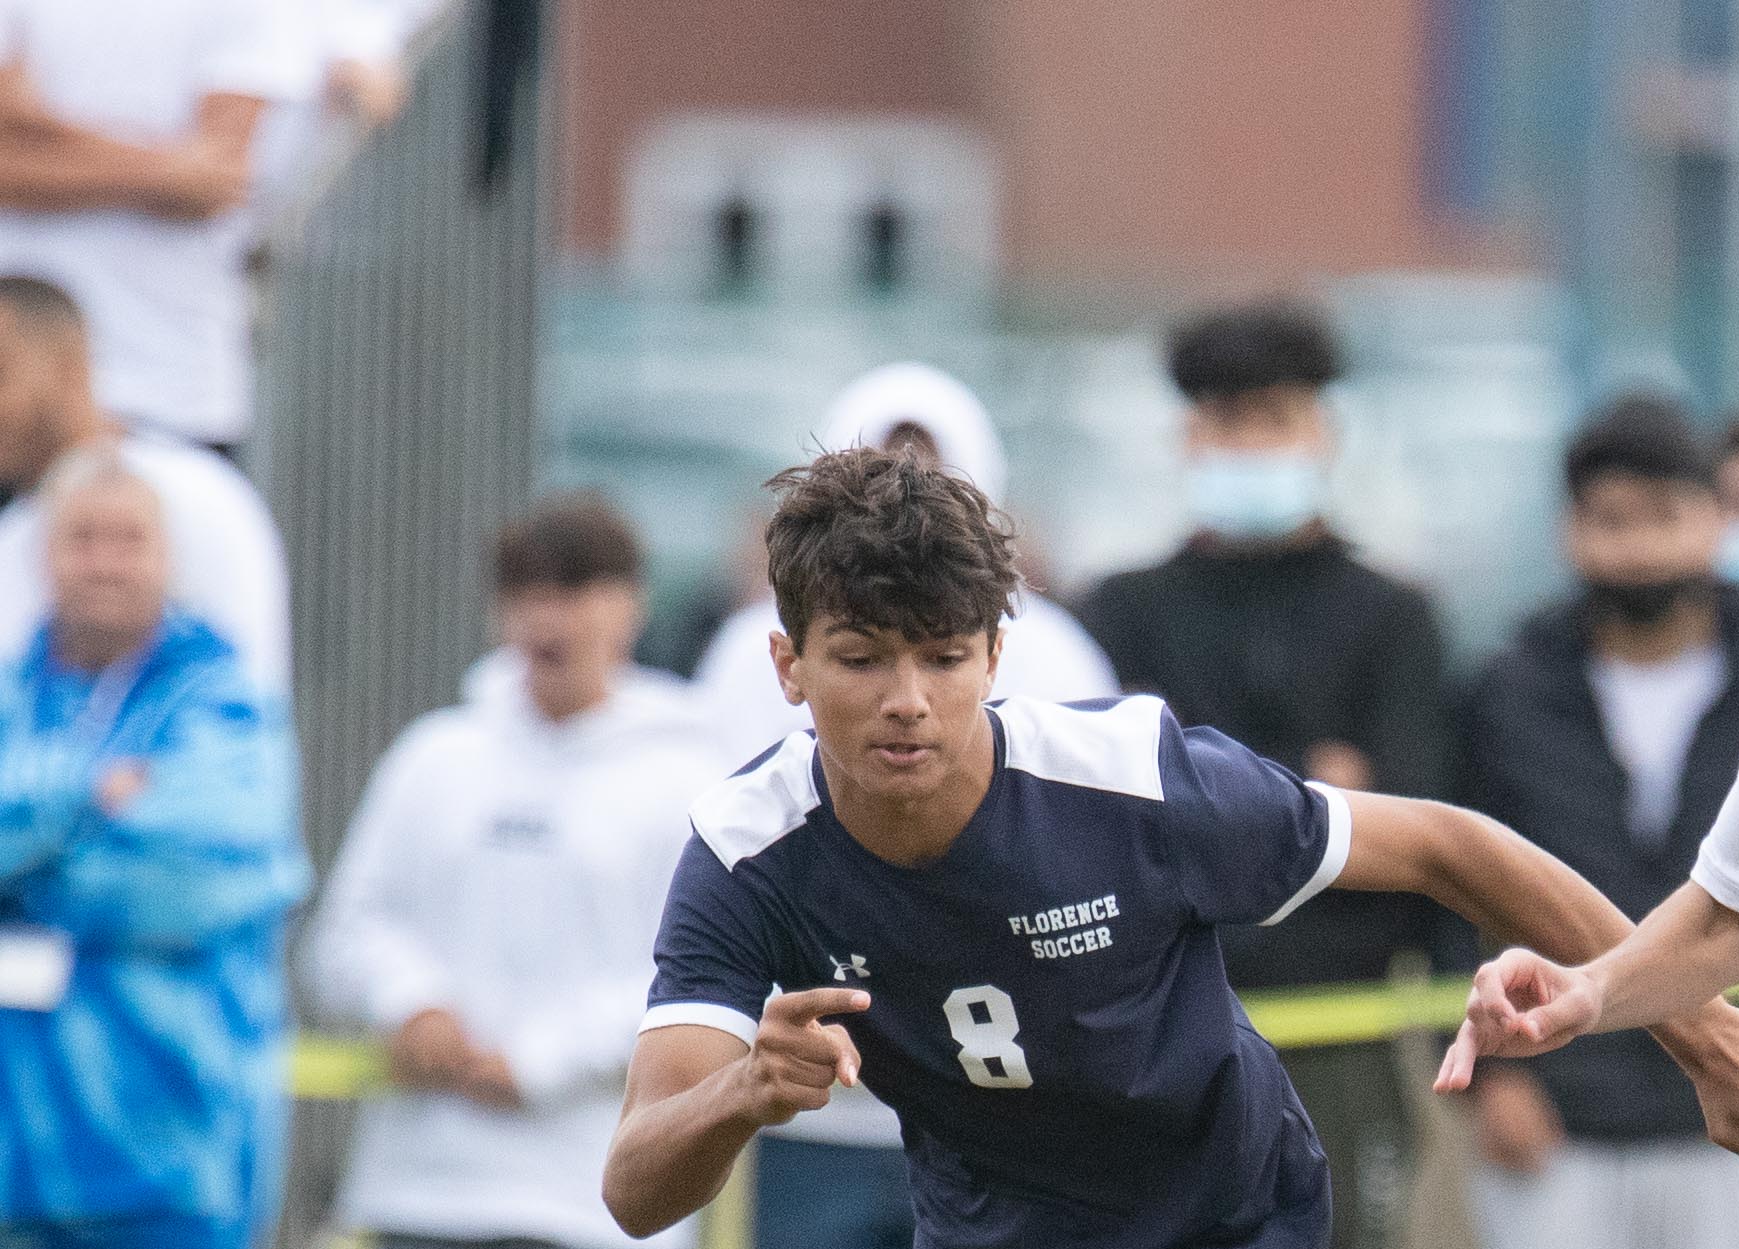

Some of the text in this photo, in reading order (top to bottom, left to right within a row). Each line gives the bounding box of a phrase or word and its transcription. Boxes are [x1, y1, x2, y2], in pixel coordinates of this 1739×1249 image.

[1008, 894, 1120, 935] FLORENCE
[1031, 926, 1113, 959] SOCCER
[943, 984, 1033, 1088] 8
